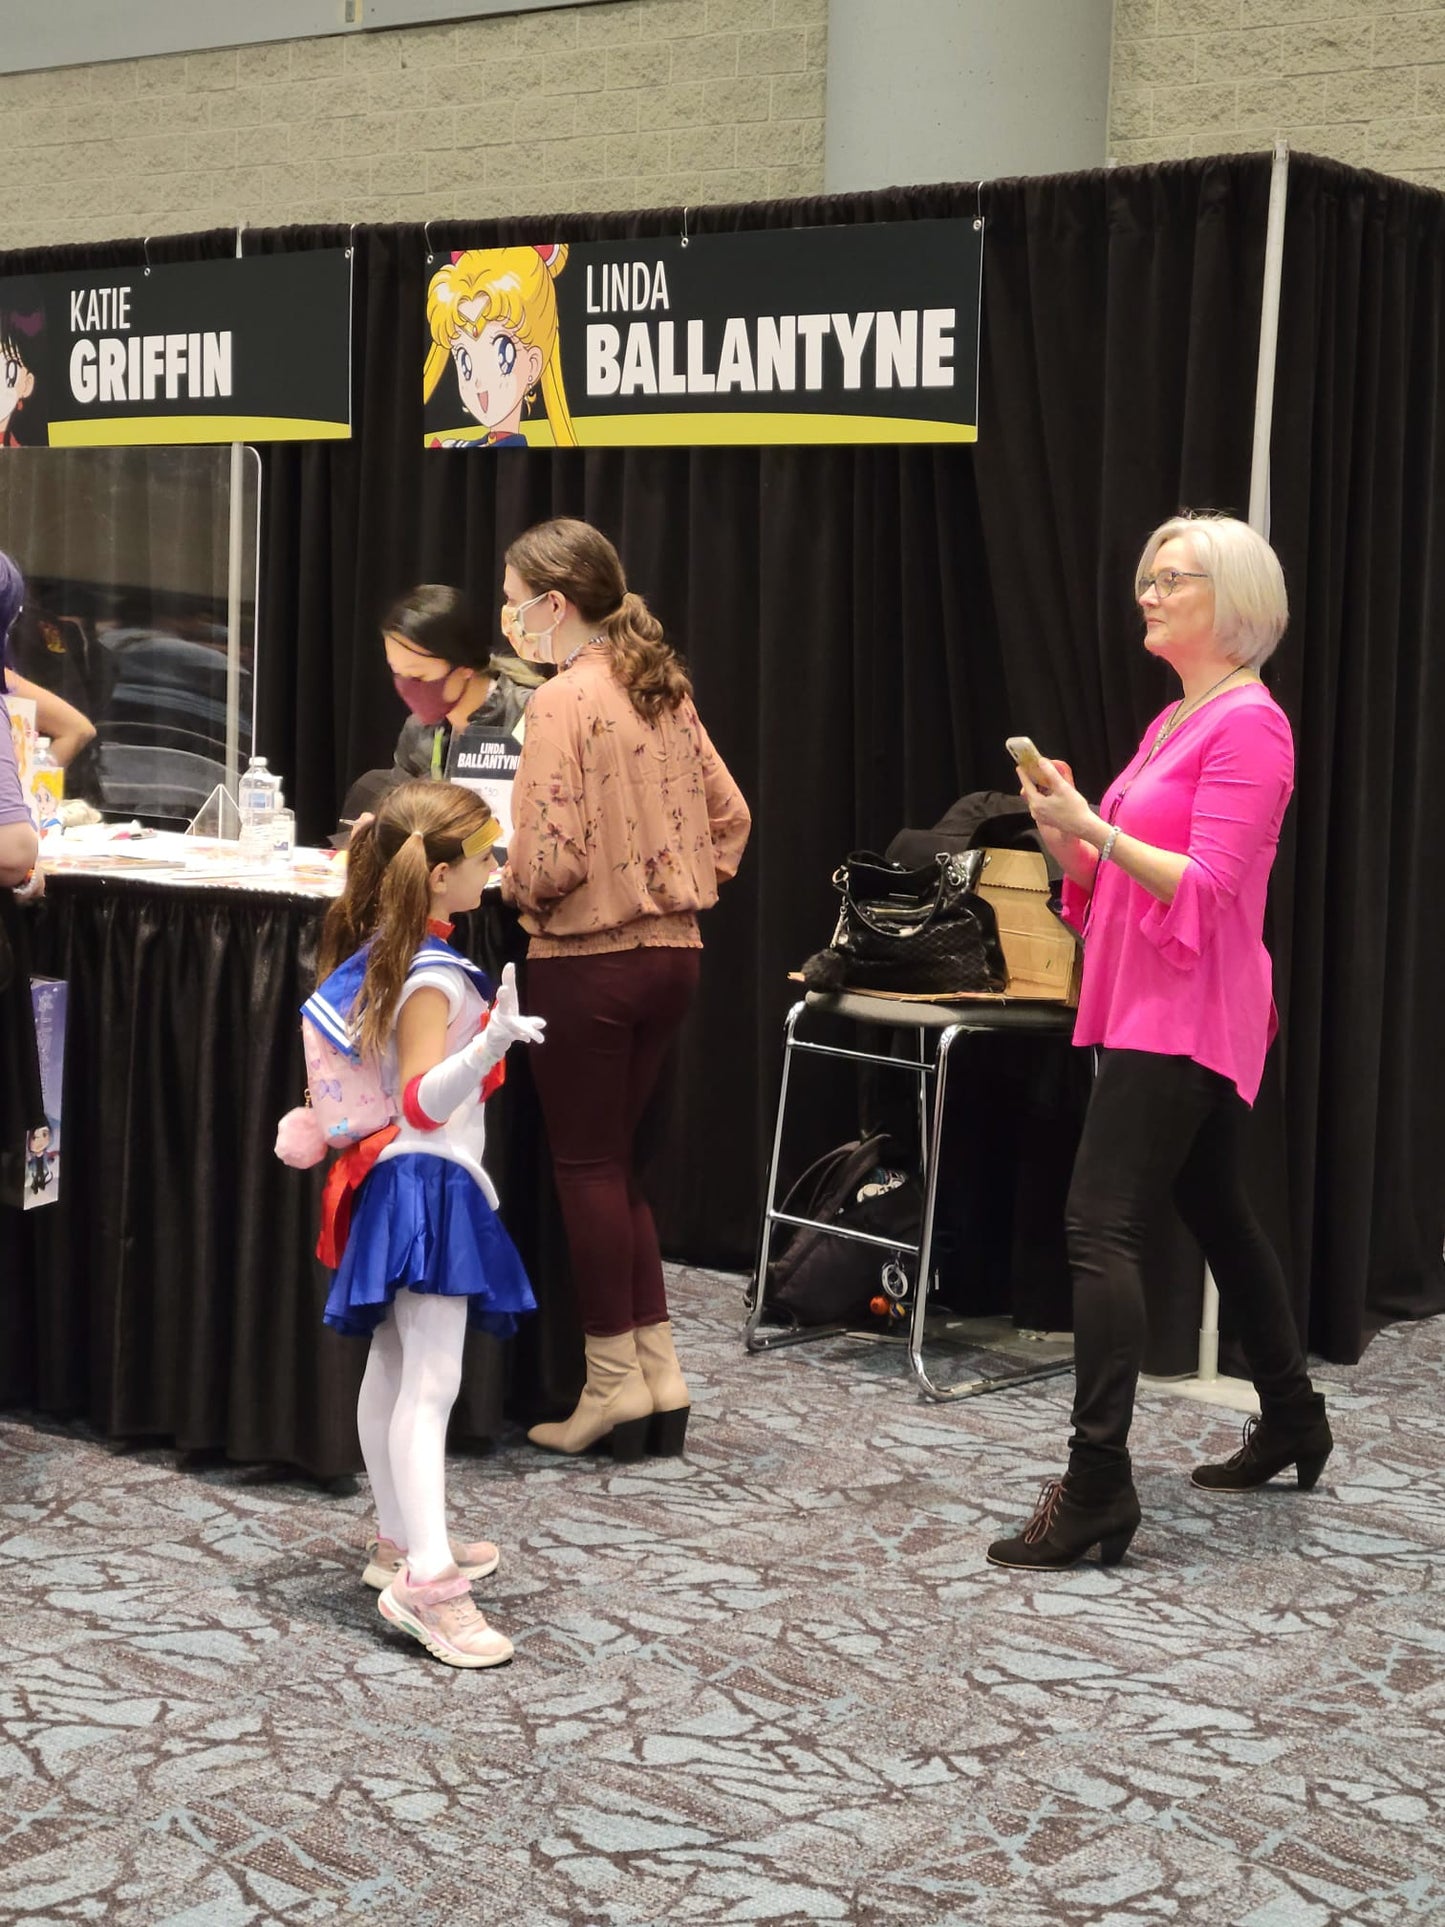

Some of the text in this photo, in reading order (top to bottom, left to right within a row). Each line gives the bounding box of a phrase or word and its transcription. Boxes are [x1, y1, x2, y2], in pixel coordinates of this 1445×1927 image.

[69, 286, 131, 332] KATIE
[586, 260, 670, 313] LINDA
[69, 331, 233, 404] GRIFFIN
[586, 308, 956, 396] BALLANTYNE
[480, 742, 505, 755] LINDA
